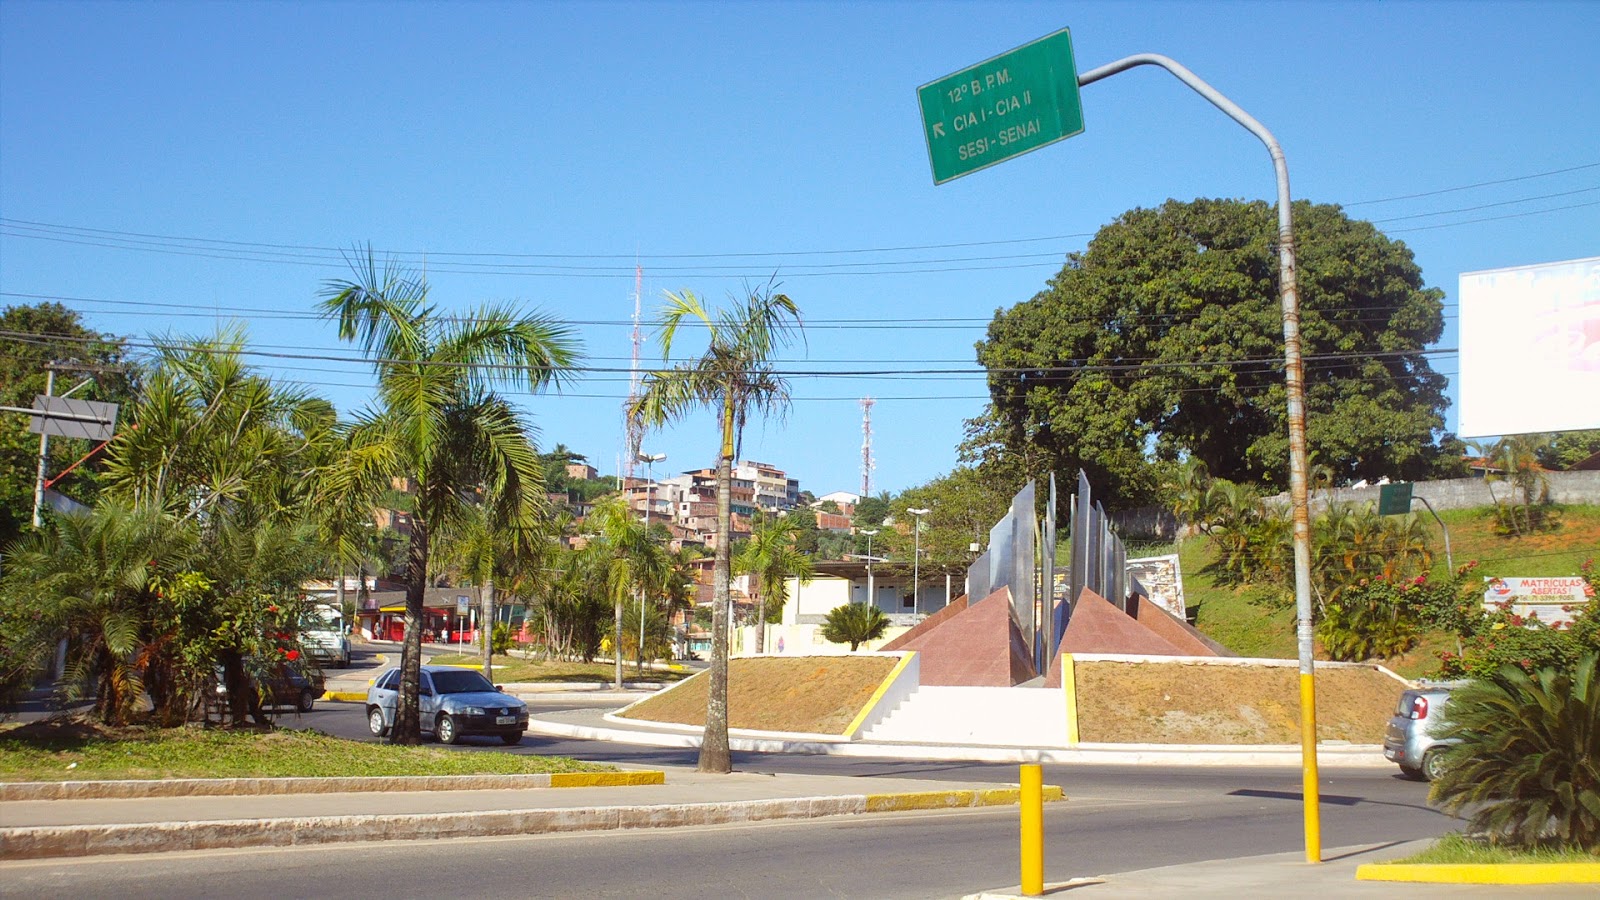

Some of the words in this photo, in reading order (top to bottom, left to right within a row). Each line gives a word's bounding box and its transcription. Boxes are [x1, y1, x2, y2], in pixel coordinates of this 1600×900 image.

[953, 110, 978, 132] CIA
[995, 95, 1021, 116] CIA
[958, 138, 989, 161] SESI
[999, 119, 1041, 146] SENAI
